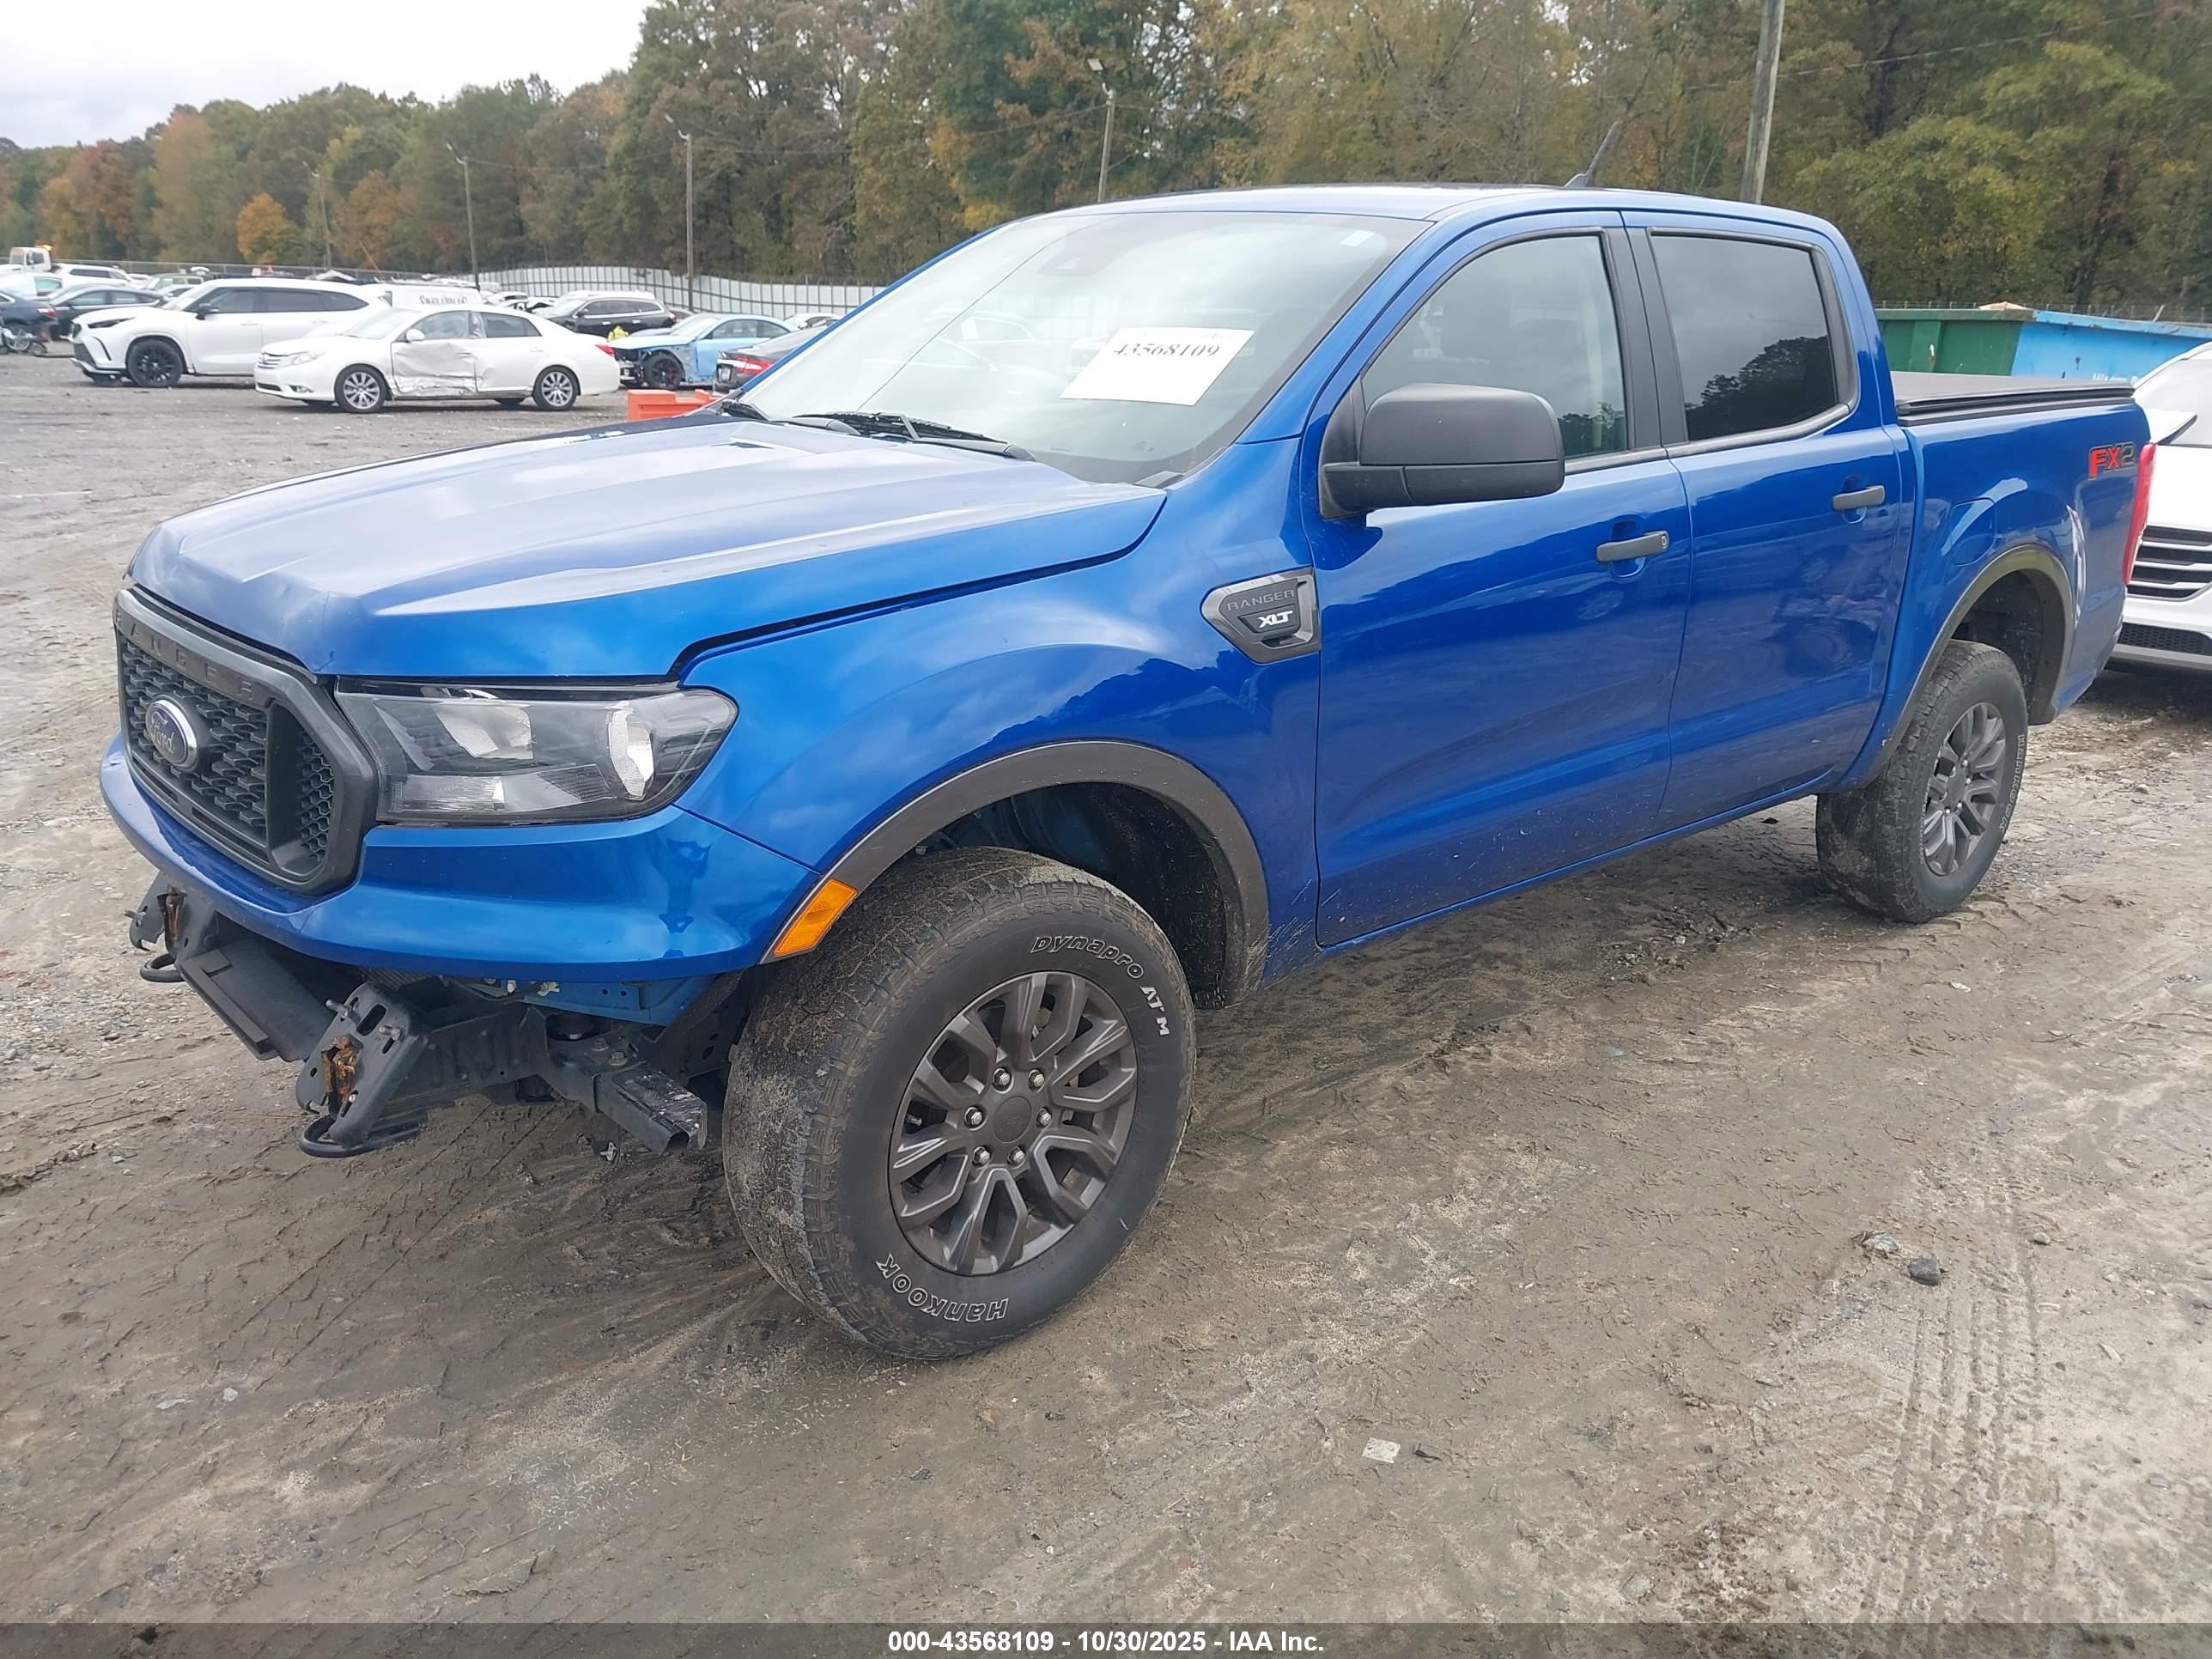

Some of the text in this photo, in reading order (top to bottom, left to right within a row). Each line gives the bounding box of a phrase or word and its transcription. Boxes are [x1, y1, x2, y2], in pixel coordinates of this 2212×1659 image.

[1113, 343, 1220, 357] 43568109
[2088, 442, 2136, 480] FX2
[1226, 589, 1295, 611] RANGER
[1256, 610, 1293, 629] XLT
[150, 711, 176, 755] Ford
[1030, 935, 1144, 979] Dynapro
